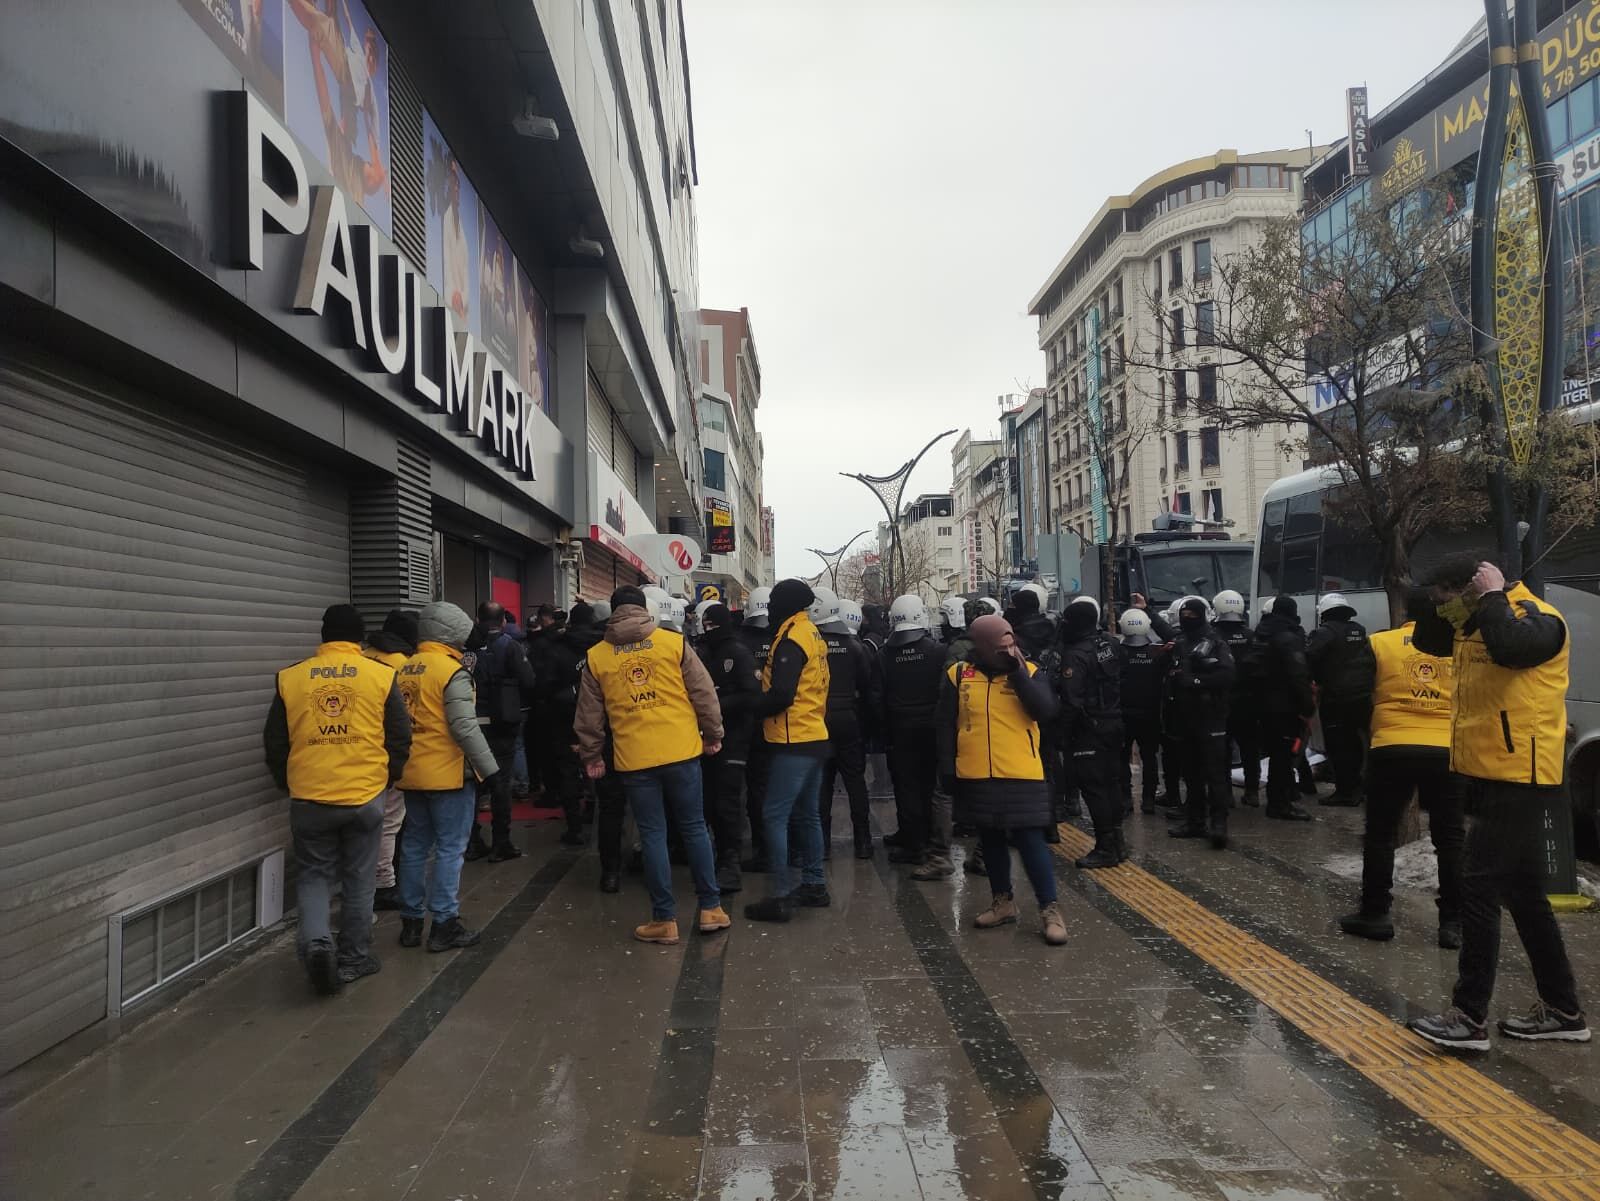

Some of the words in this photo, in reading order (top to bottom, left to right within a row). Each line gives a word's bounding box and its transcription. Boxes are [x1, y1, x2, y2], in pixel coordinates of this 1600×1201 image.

[1352, 104, 1368, 165] MASAL
[246, 90, 537, 480] PAULMARK
[310, 663, 358, 679] POLİS
[630, 690, 656, 703] VAN
[1411, 689, 1440, 699] VAN
[318, 724, 348, 735] VAN
